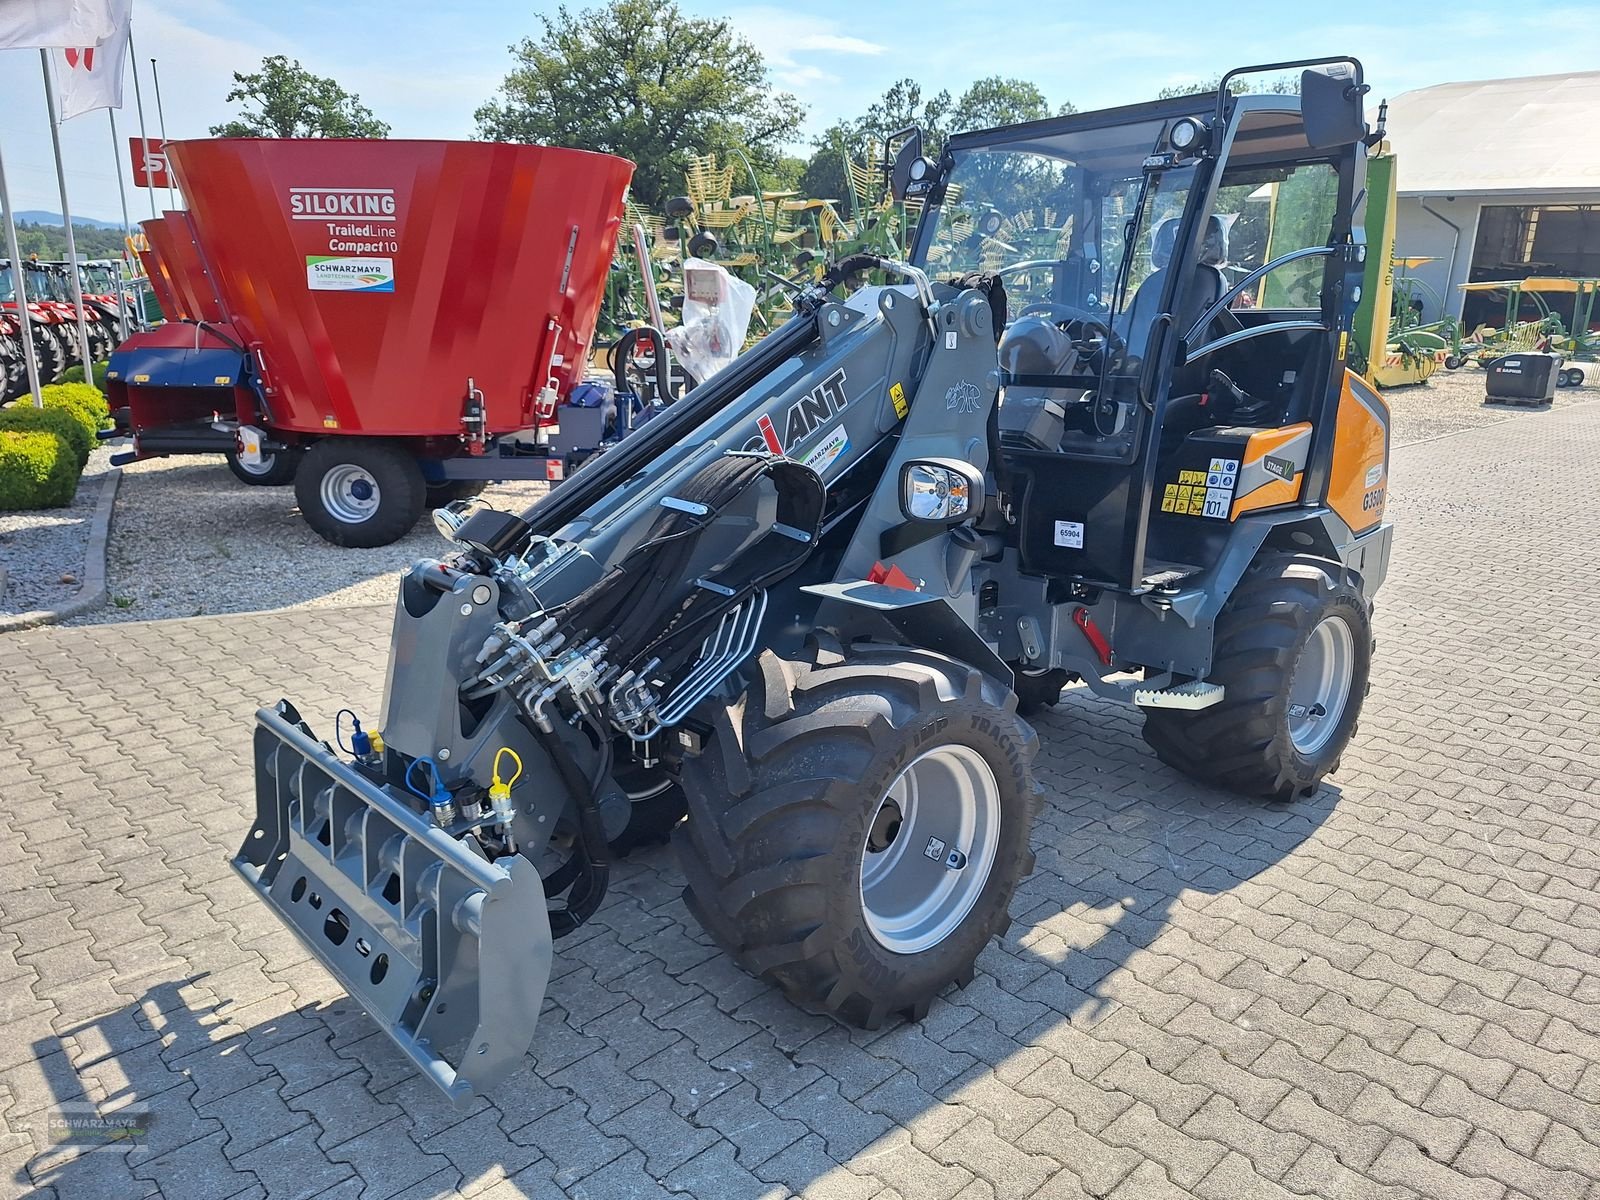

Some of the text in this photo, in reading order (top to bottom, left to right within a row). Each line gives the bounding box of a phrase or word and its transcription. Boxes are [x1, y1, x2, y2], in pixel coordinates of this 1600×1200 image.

[290, 194, 396, 215] SILOKING
[326, 223, 397, 238] TrailedLine
[314, 264, 382, 273] SCHWARZMAYR
[805, 436, 840, 467] HWARZMAYR
[1266, 461, 1294, 477] STAGE V
[1206, 500, 1221, 516] 101
[1060, 529, 1080, 538] 65904
[969, 714, 1025, 795] TRACTION
